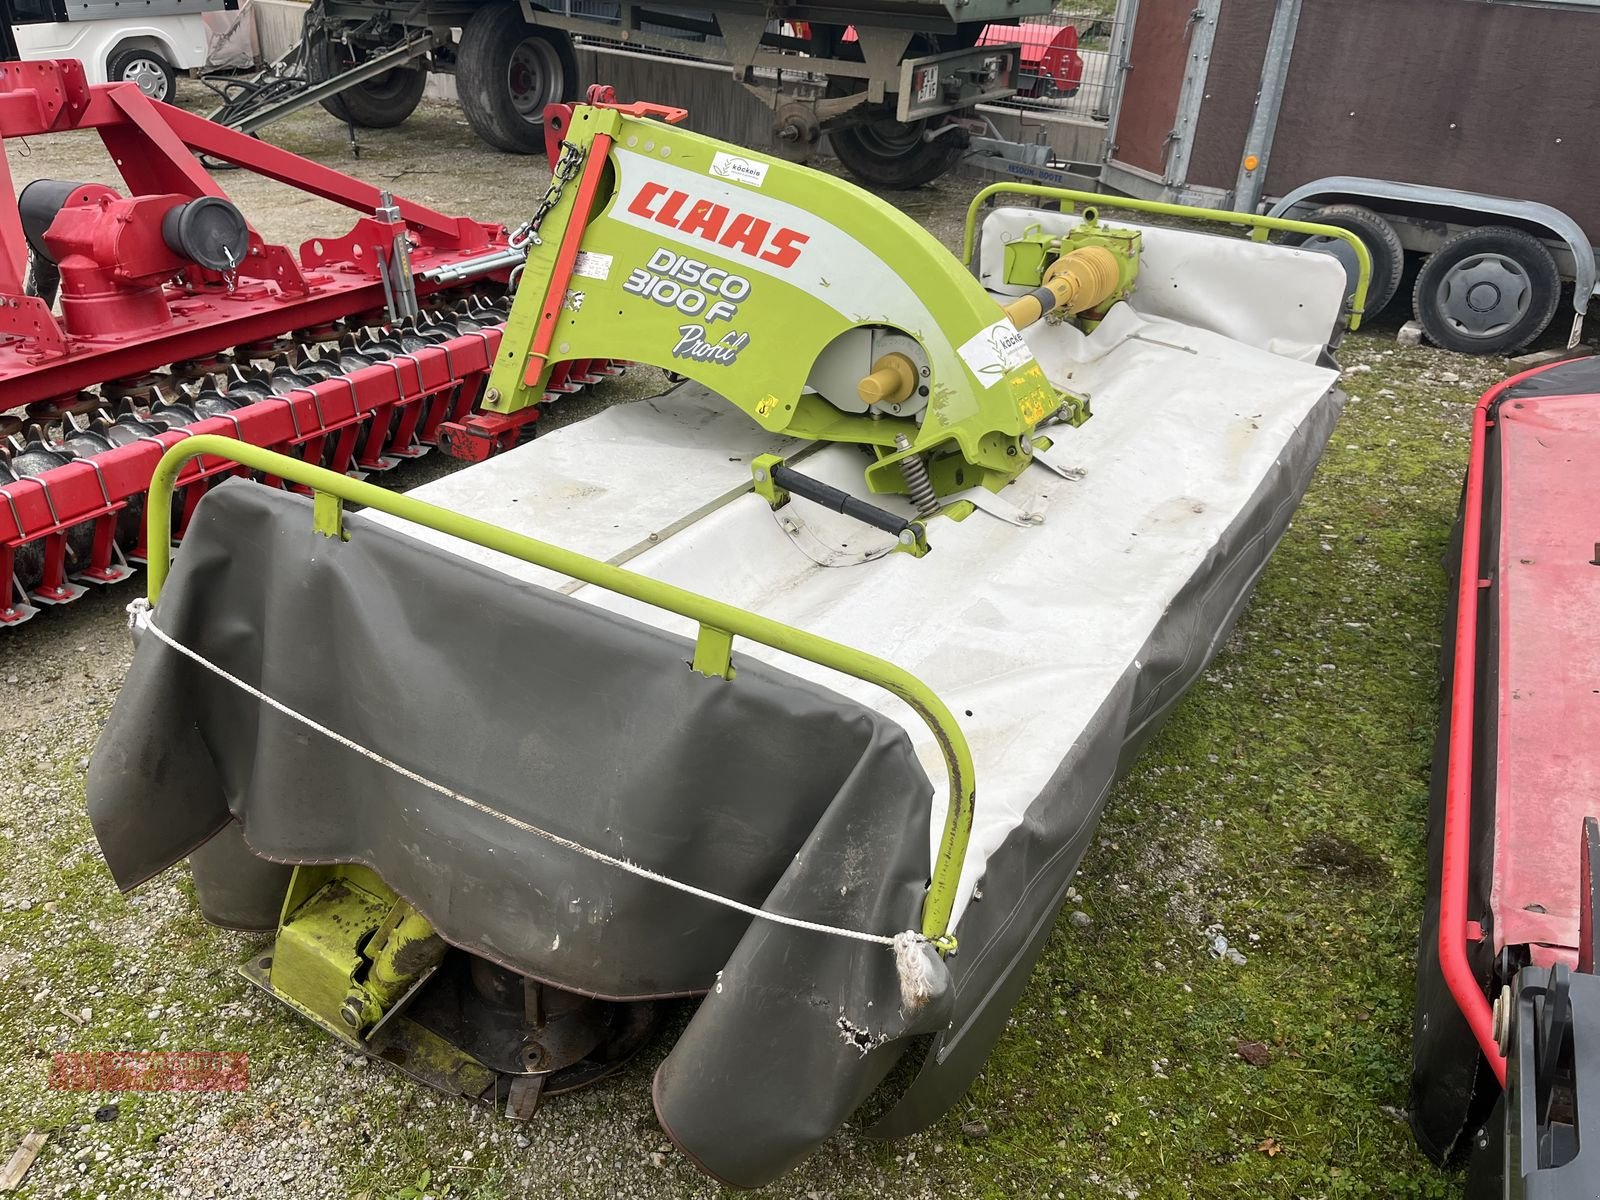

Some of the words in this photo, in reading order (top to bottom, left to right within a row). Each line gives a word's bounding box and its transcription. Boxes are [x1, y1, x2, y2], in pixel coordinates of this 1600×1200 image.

[628, 182, 811, 268] CLAAS
[623, 267, 707, 316] 3100
[704, 301, 738, 323] F
[646, 247, 751, 303] DISCO
[672, 324, 750, 366] Profil
